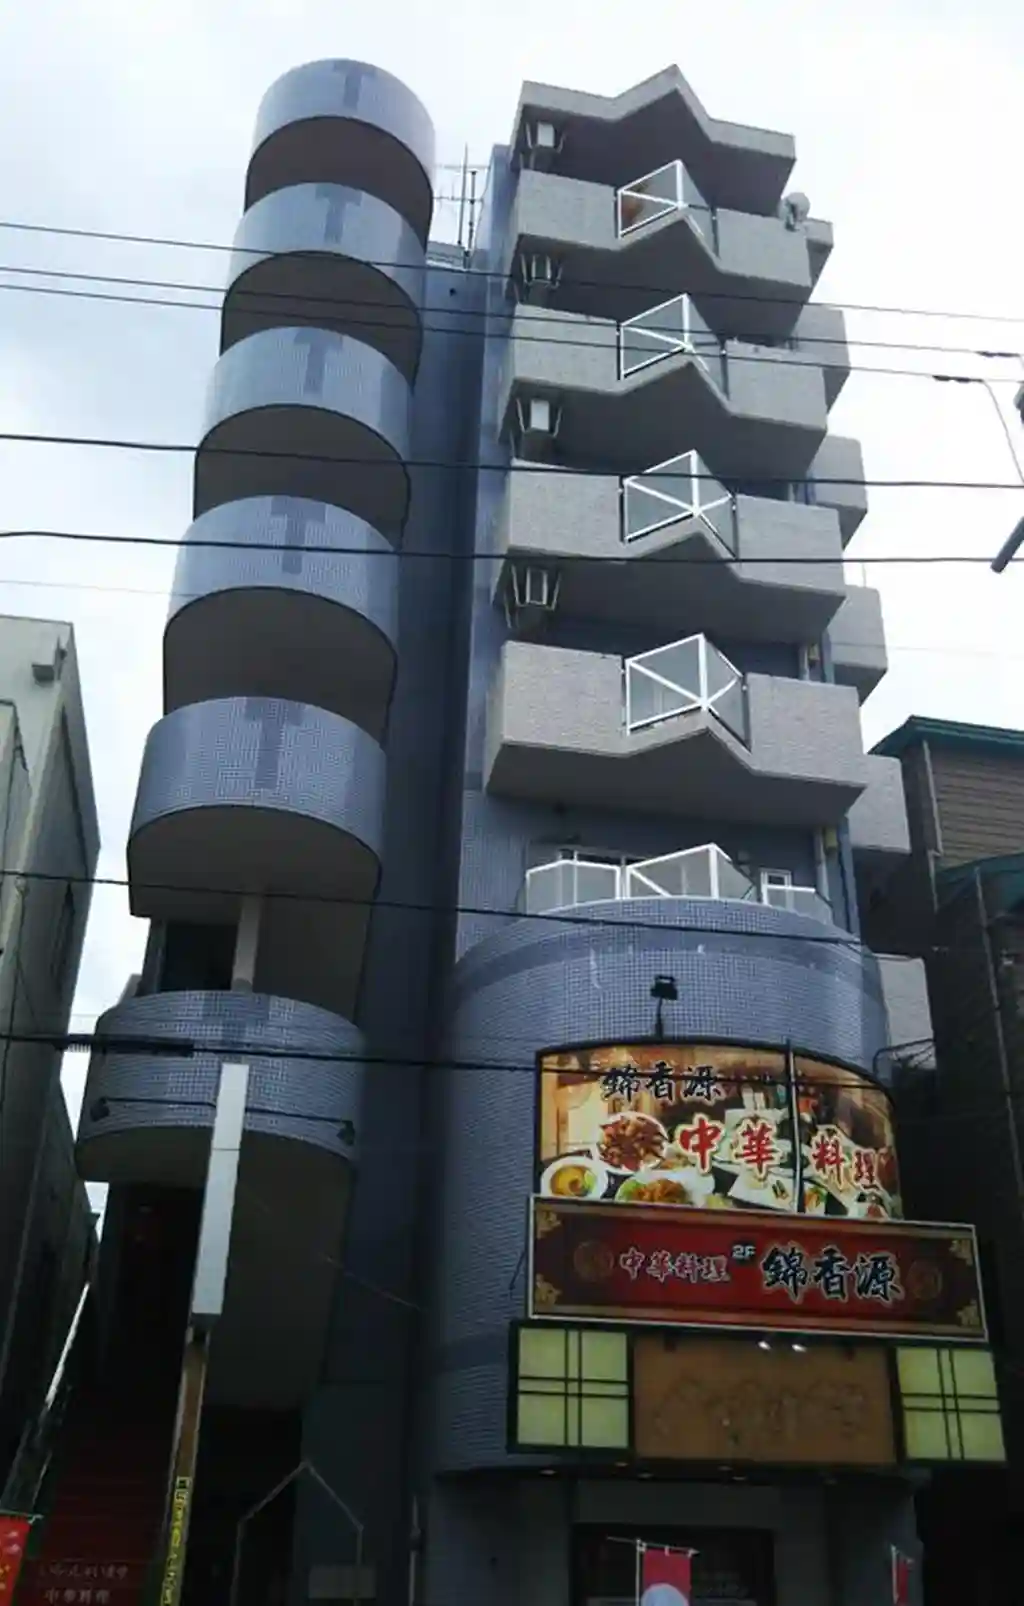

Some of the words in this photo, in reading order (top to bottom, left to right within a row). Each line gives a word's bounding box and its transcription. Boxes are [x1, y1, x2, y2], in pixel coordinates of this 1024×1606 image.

[602, 1061, 724, 1102] 錦香源
[677, 1115, 878, 1192] 中華料理
[620, 1247, 730, 1282] 中華料理
[732, 1244, 756, 1260] 2F
[761, 1242, 903, 1303] 錦香源
